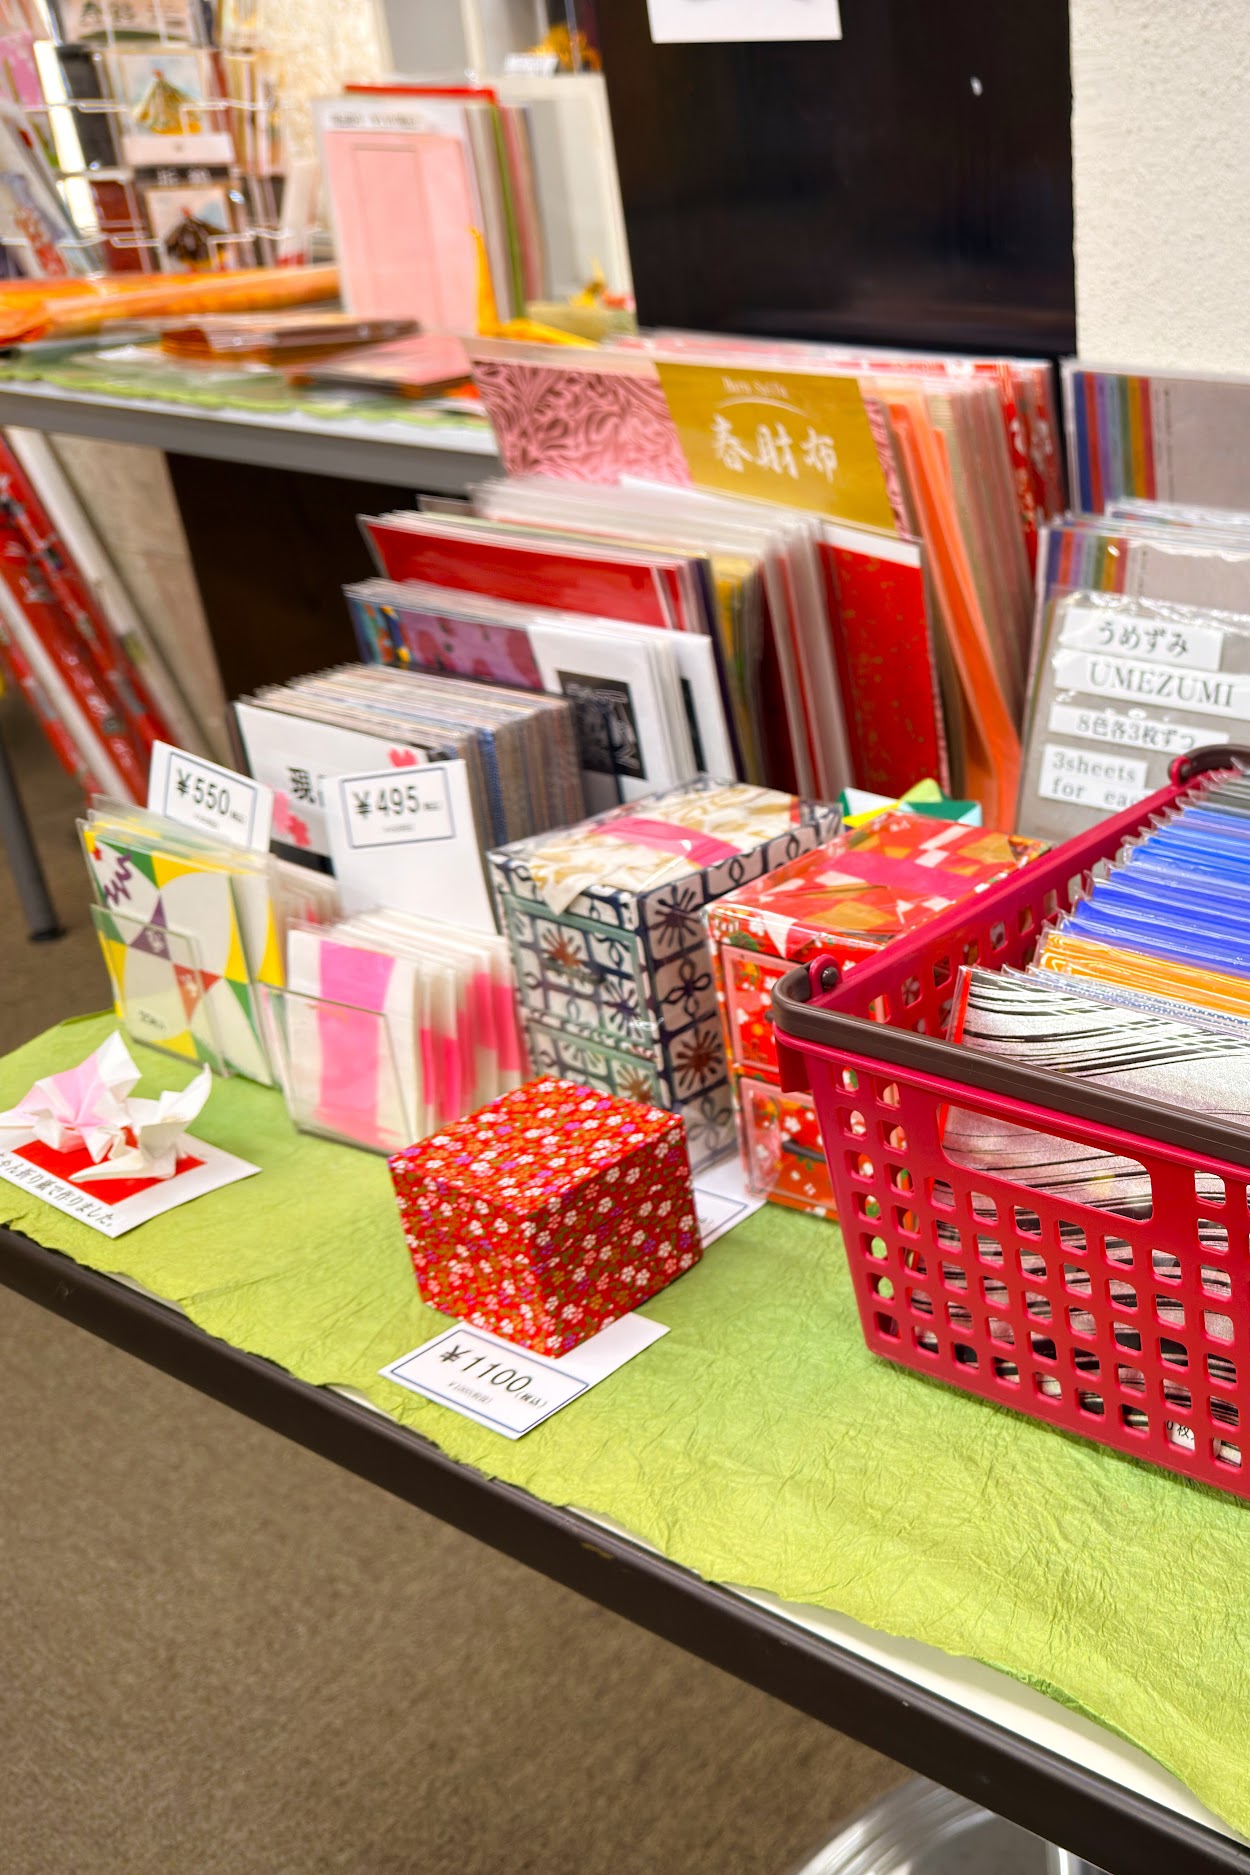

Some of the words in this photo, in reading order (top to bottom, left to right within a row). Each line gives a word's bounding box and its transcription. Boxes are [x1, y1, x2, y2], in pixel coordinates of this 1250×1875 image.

[1100, 621, 1188, 658] うめずみ
[1089, 660, 1236, 708] UMEZUMI
[1076, 713, 1196, 750] 8色各3枚ずつ
[1053, 750, 1137, 783] 3sheets
[176, 767, 231, 816] ¥550
[353, 784, 421, 820] ¥495
[1052, 776, 1086, 800] for
[440, 1344, 533, 1393] ¥1100
